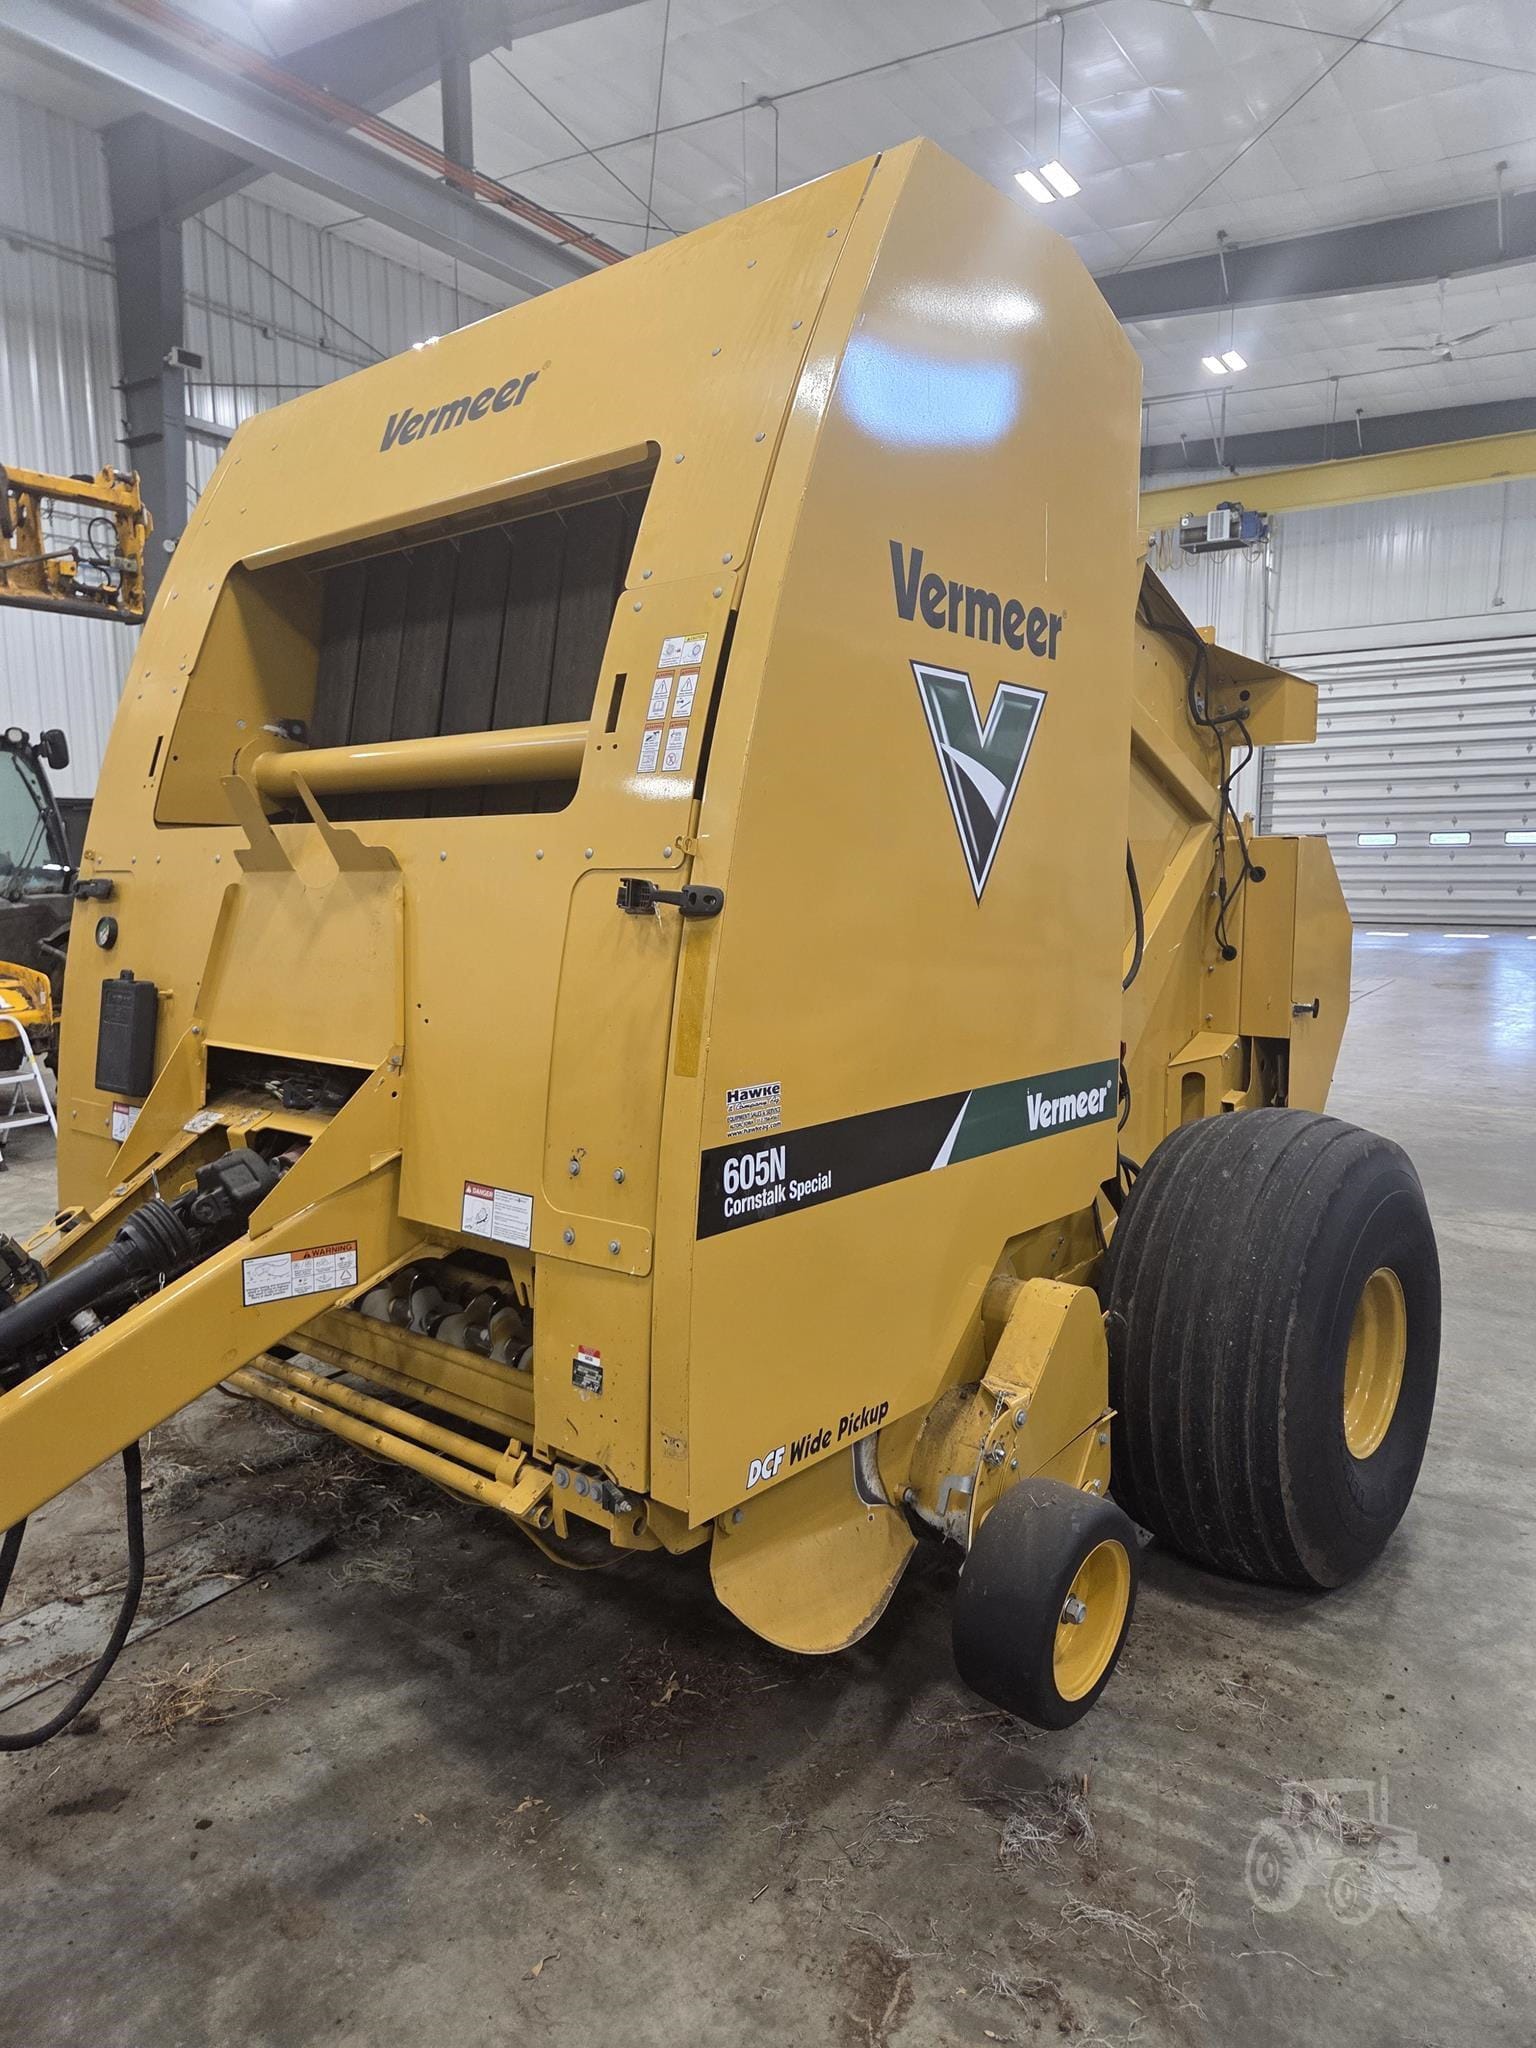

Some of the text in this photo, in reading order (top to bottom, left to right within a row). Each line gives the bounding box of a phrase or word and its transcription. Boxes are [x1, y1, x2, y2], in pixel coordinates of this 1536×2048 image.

[379, 370, 541, 453] Vermeer
[889, 539, 1062, 660] Vermeer
[1026, 1087, 1107, 1131] Vermeer
[723, 1145, 786, 1195] 605N
[724, 1169, 832, 1218] Cornstalk Special
[312, 1243, 353, 1257] WARNING
[746, 1401, 889, 1490] DCF Wide Pickup
